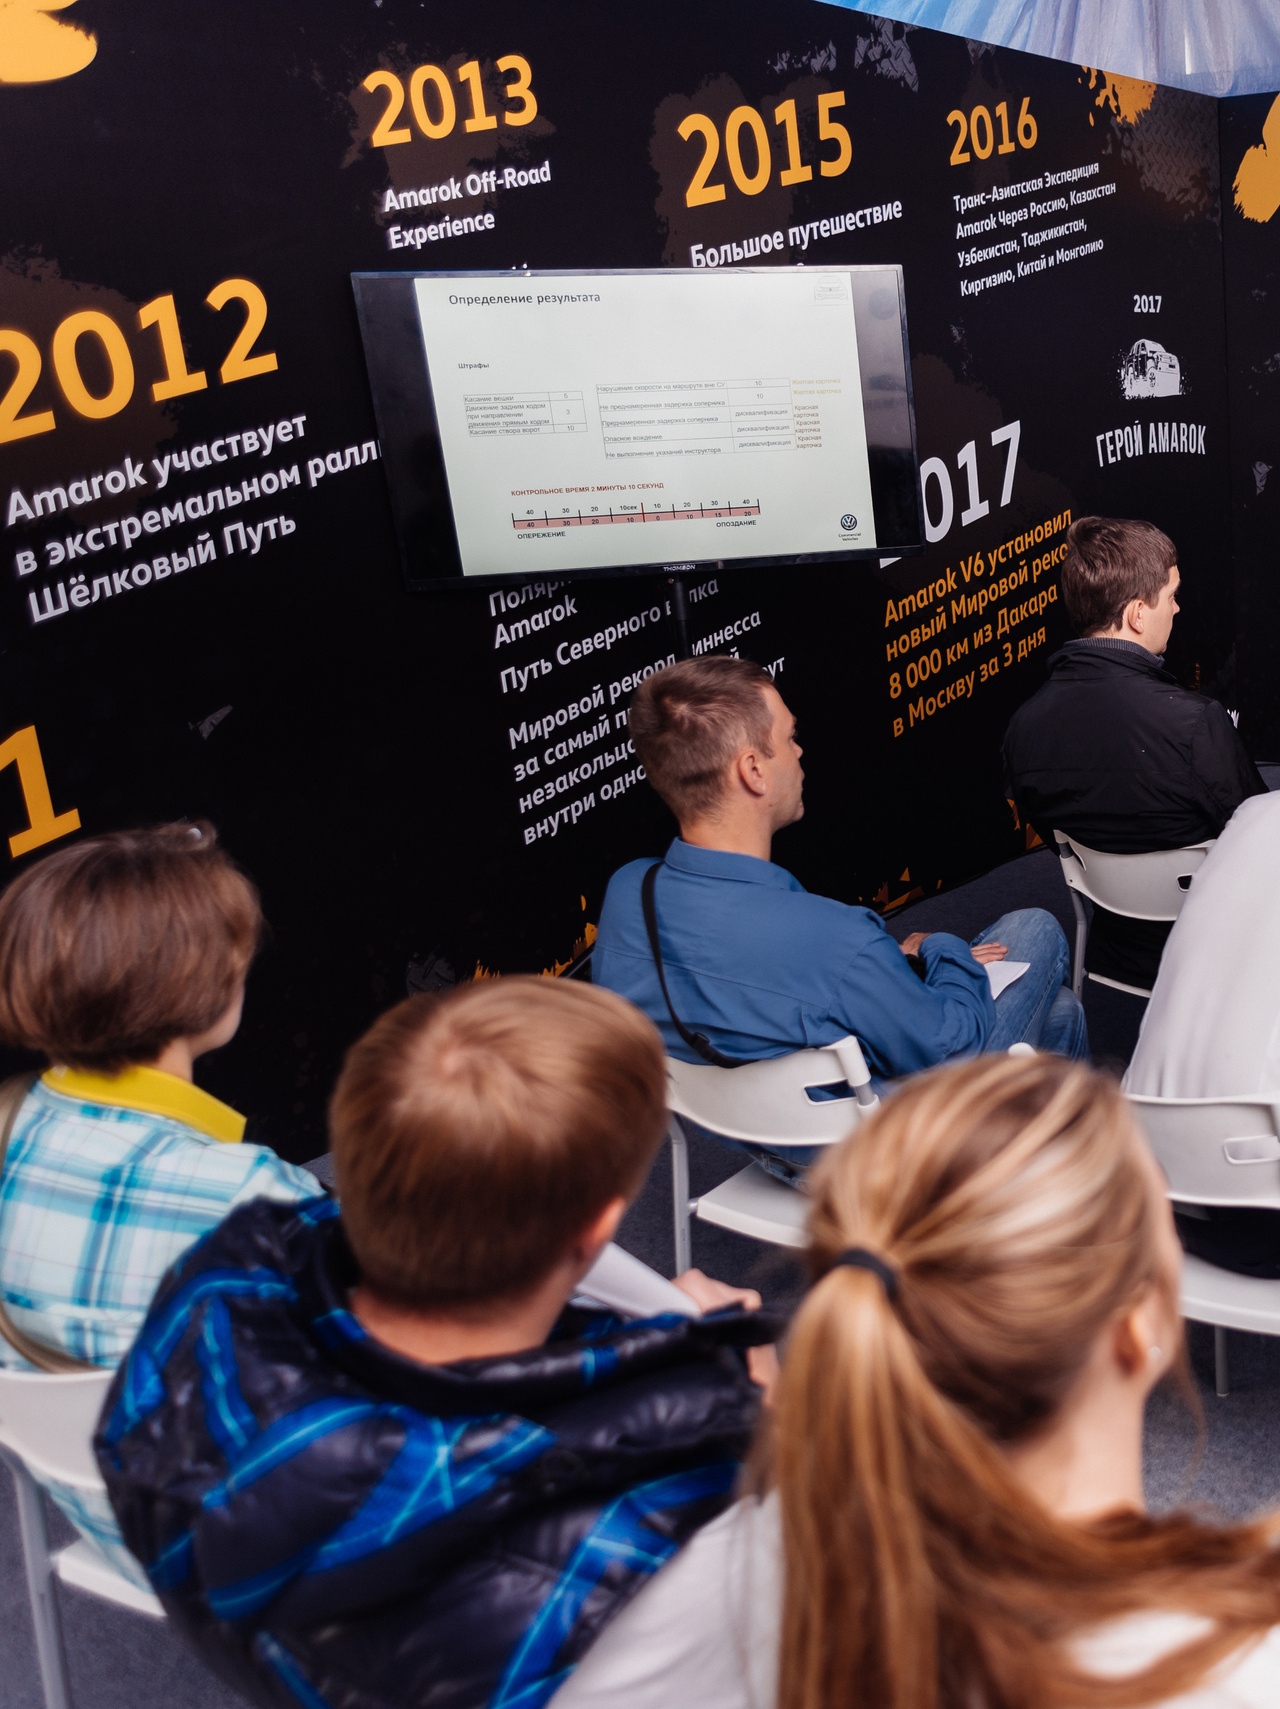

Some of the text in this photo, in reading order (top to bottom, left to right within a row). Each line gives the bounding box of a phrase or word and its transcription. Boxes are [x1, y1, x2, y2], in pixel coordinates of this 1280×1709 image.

[362, 54, 539, 148] 2013
[677, 90, 853, 208] 2015
[946, 96, 1038, 166] 2016
[384, 160, 552, 212] Amarok Off-Road
[1043, 162, 1100, 189] Экспедиция
[388, 212, 496, 251] Experience
[690, 200, 904, 268] Большое путешествие
[955, 182, 1117, 240] Amarok Через Россию, Казахстан
[957, 217, 1088, 268] Узбекистан, Таджикистан,
[960, 238, 1105, 297] Киргизию, Китай и Монголию
[449, 293, 601, 306] Определение результата
[1133, 294, 1162, 313] 2017
[0, 276, 279, 444] 2012
[458, 362, 489, 370] Штрафы
[464, 395, 492, 403] Касание
[465, 402, 546, 412] Движение задним ходом
[597, 384, 633, 393] Нарушение
[634, 383, 663, 392] скорости
[672, 382, 703, 391] маршруте
[663, 401, 693, 410] задержка
[693, 399, 726, 408] соперника
[469, 428, 497, 436] Касание
[480, 411, 524, 420] направлении
[529, 418, 550, 426] ходом
[633, 434, 663, 442] вождение
[656, 417, 686, 426] задержка
[686, 415, 719, 424] соперника
[655, 448, 684, 457] указаний
[1096, 420, 1207, 468] ГЕРОЙ AMAROK
[7, 414, 307, 526] Amarok участвует
[511, 487, 564, 496] КОНТРОЛЬНОЕ
[596, 484, 627, 492] МИНУТЫ
[636, 482, 665, 491] СЕКУНД
[899, 420, 1021, 560] 017
[15, 439, 382, 577] в экстремальном ралл
[619, 504, 638, 512] 10сек
[716, 519, 757, 528] ОПОЗДАНИЕ
[517, 530, 566, 540] ОПЕРЕЖЕНИЕ
[28, 514, 297, 624] Шёлковый Путь
[884, 509, 1072, 628] Amarok V6 установил
[494, 594, 578, 650] Amarok
[886, 606, 947, 662] новый
[951, 560, 1028, 624] Мировой
[500, 657, 553, 694] Путь
[556, 605, 661, 667] Северного
[889, 582, 1058, 700] 8 000 км из Дакара
[509, 684, 606, 750] Мировой
[691, 610, 762, 656] иннесса
[892, 625, 1048, 738] в Москву за 3 дня
[513, 757, 541, 782] за
[543, 714, 611, 766] самый
[523, 791, 596, 845] внутри
